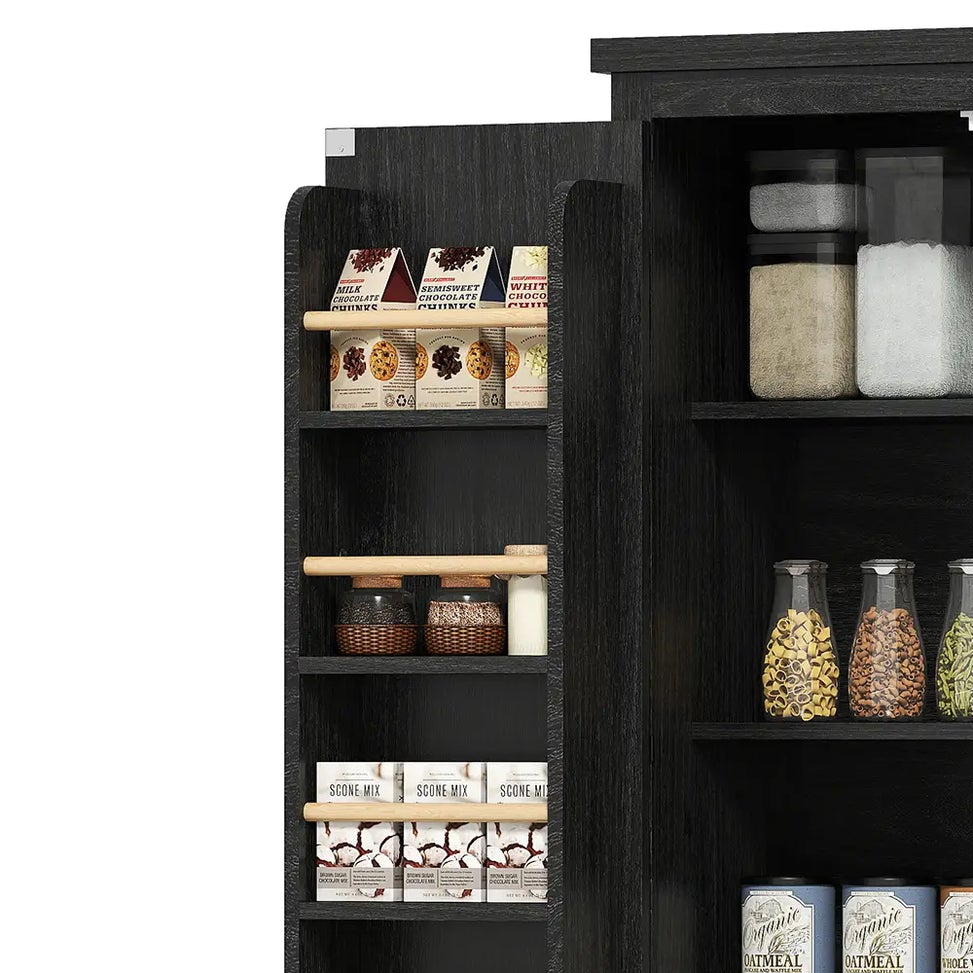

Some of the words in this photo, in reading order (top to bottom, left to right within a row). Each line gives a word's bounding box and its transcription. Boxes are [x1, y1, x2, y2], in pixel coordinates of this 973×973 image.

[336, 286, 362, 294] MILK
[421, 284, 480, 292] SEMISWEET
[333, 294, 380, 304] CHOCOLATE
[330, 784, 359, 796] SCONE
[364, 784, 380, 796] MIX
[417, 784, 446, 797] SCONE
[451, 784, 468, 797] MIX
[500, 784, 530, 797] SCONE
[742, 906, 800, 951] Organic
[844, 908, 902, 950] Organic
[744, 954, 802, 968] OATMEAL
[845, 955, 904, 968] OATMEAL
[942, 958, 968, 969] WHOLE
